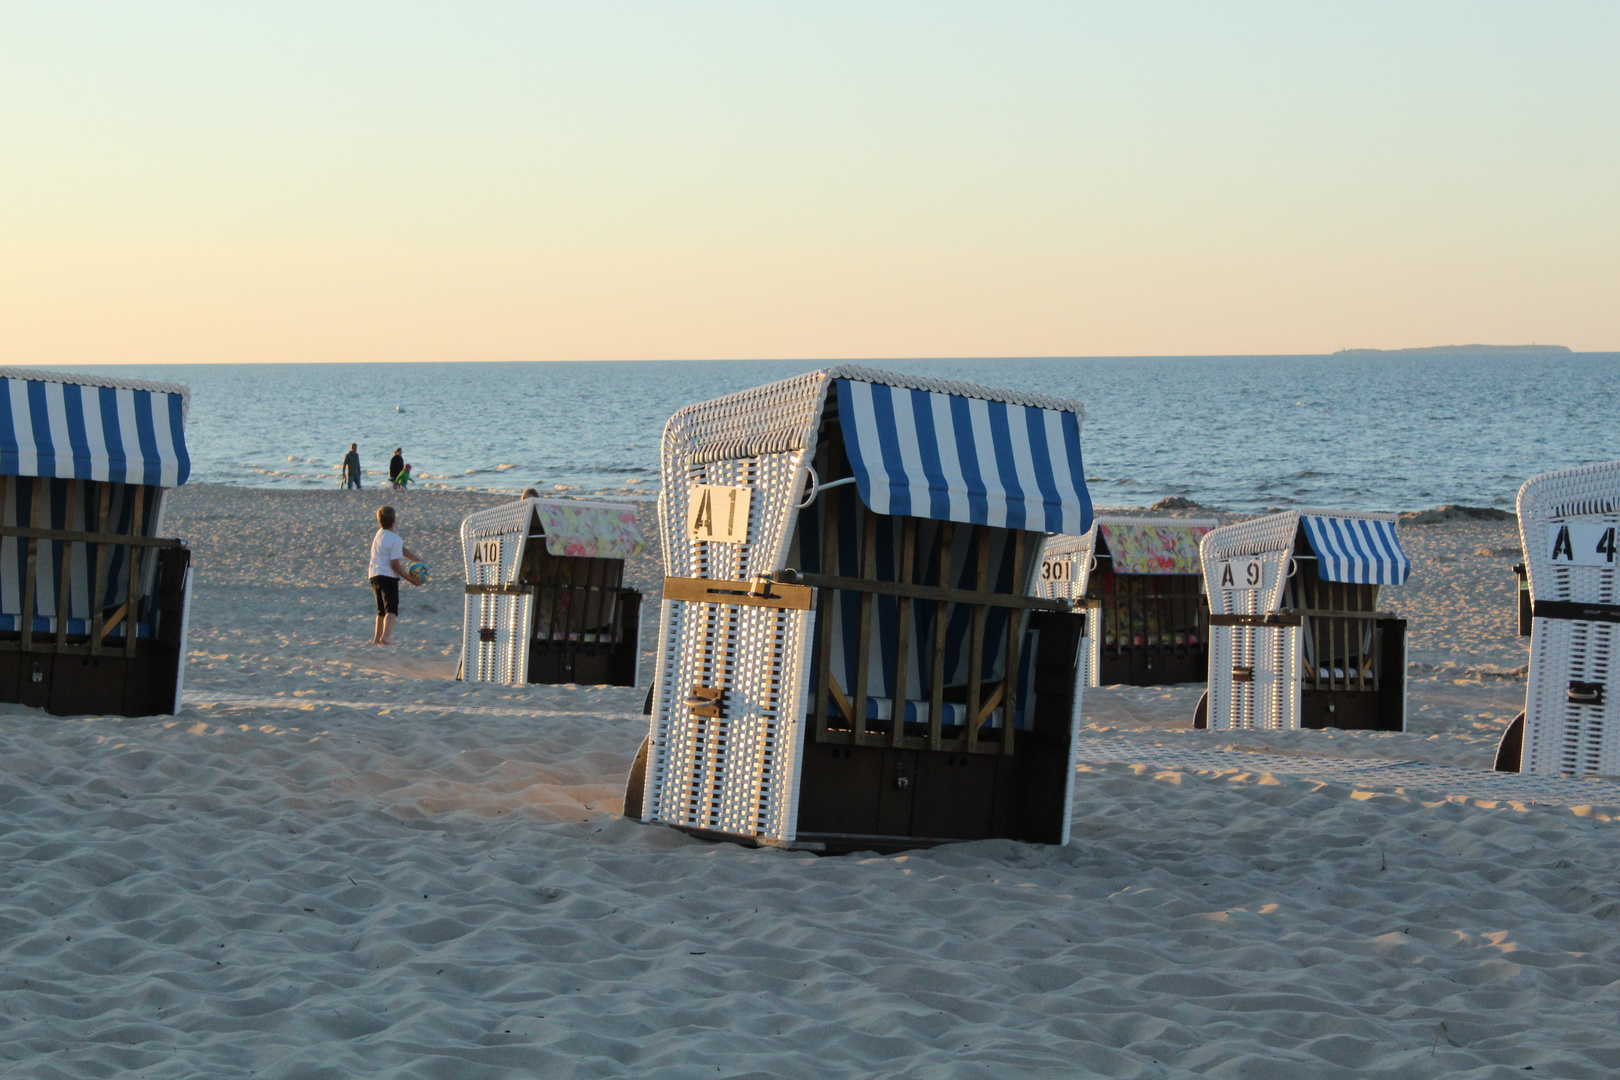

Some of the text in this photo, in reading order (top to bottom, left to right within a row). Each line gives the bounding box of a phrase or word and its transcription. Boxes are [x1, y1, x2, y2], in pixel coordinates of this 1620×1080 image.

[693, 488, 737, 536] A 1
[473, 542, 497, 563] A10
[1551, 525, 1617, 562] A 4
[1042, 561, 1069, 580] 301
[1221, 562, 1259, 586] A 9
